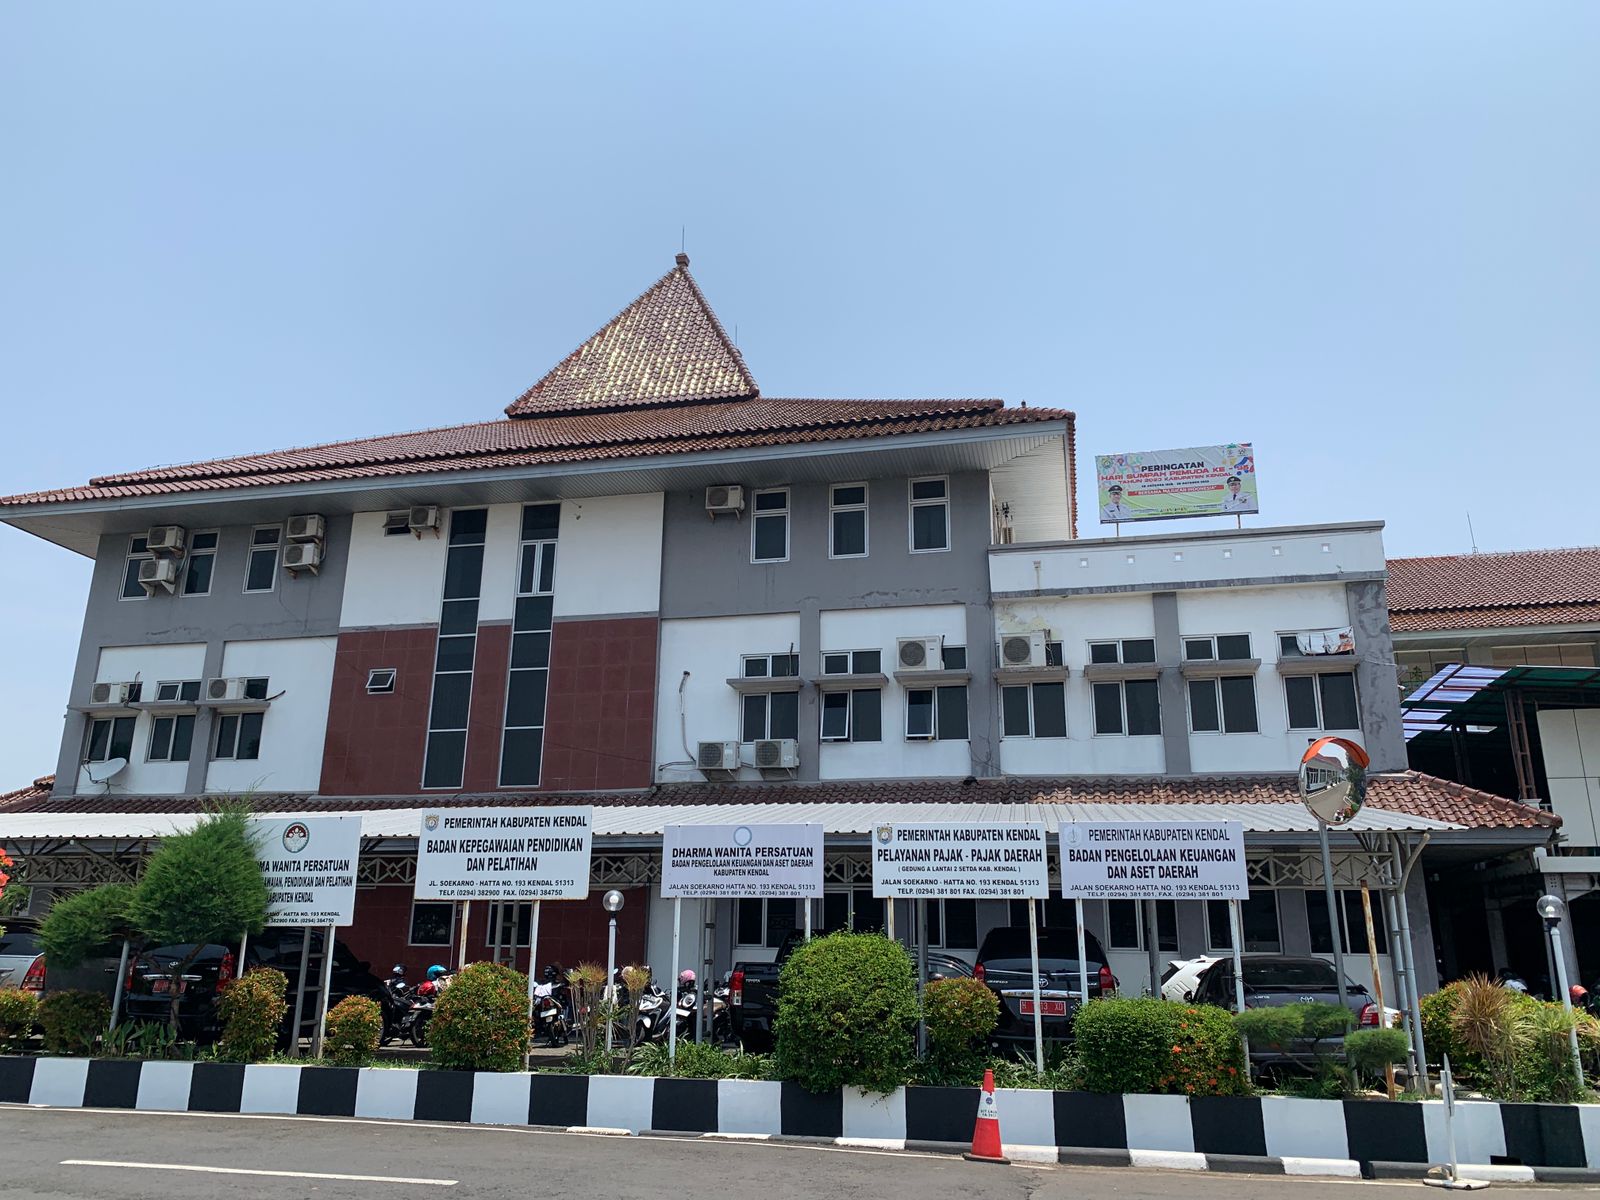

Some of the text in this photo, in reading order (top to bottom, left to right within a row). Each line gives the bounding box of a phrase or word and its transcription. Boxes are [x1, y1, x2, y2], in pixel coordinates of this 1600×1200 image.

[1141, 461, 1204, 472] PERINGATAN
[444, 816, 587, 829] PEMERINTAH KABUPATEN KENDAL
[897, 830, 1041, 841] PEMERINTAH KABUPATEN KENDAL
[1088, 829, 1230, 841] PEMERINTAH KABUPATEN KENDAL
[427, 838, 583, 853] BADAN KEPEGAWAIAN PENDIDIKAN
[672, 847, 813, 858] DHARMA WANITA PERSATUAN
[878, 849, 930, 862] PELAYANAN
[933, 849, 963, 862] PAJAK
[971, 849, 1001, 862] PAJAK
[1004, 849, 1042, 862] DAERAH
[1069, 849, 1236, 862] BADAN PENGELOLAAN KEUANGAN
[272, 860, 301, 872] WANITA
[303, 860, 350, 871] PERSATUAN
[467, 857, 538, 872] DAN PELATIHAN
[672, 860, 690, 868] BADAN
[691, 860, 730, 868] PENGELOLAAN
[731, 859, 762, 867] KEUANGAN
[763, 859, 774, 867] DAN
[775, 859, 789, 867] ASET
[713, 869, 769, 877] KABUPATEN KENDAL
[1107, 865, 1199, 879] DAN ASET DAERAH
[285, 877, 314, 887] PENDIDIKAN
[315, 876, 325, 887] DAN
[326, 876, 353, 887] PELATIHAN
[294, 892, 313, 902] KENDAL
[456, 889, 476, 897] (0294)
[518, 889, 538, 897] (0294)
